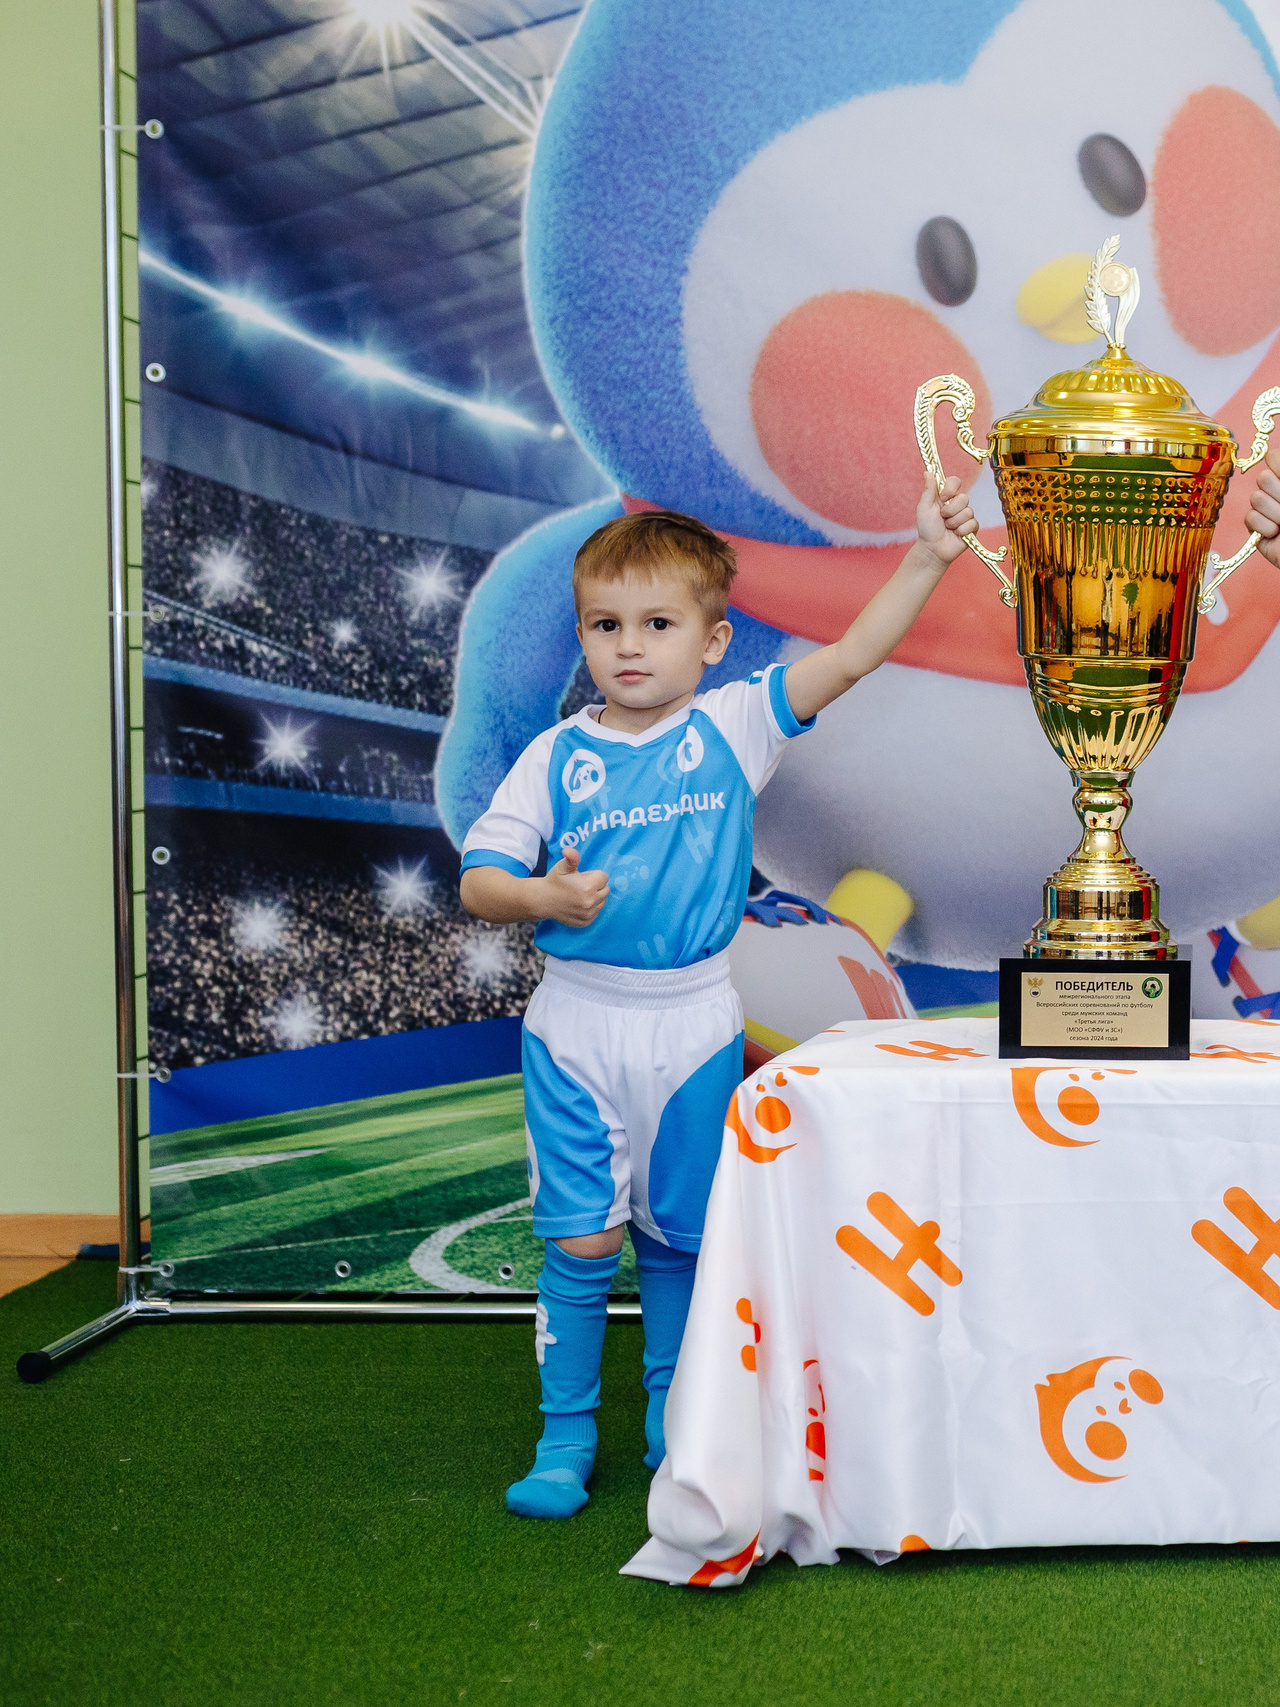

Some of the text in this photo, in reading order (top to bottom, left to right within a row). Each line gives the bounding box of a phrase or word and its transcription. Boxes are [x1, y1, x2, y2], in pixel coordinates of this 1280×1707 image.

[560, 791, 726, 849] ФК НАДЕЖДИК
[1055, 981, 1134, 992] ПОБЕДИТЕЛЬ
